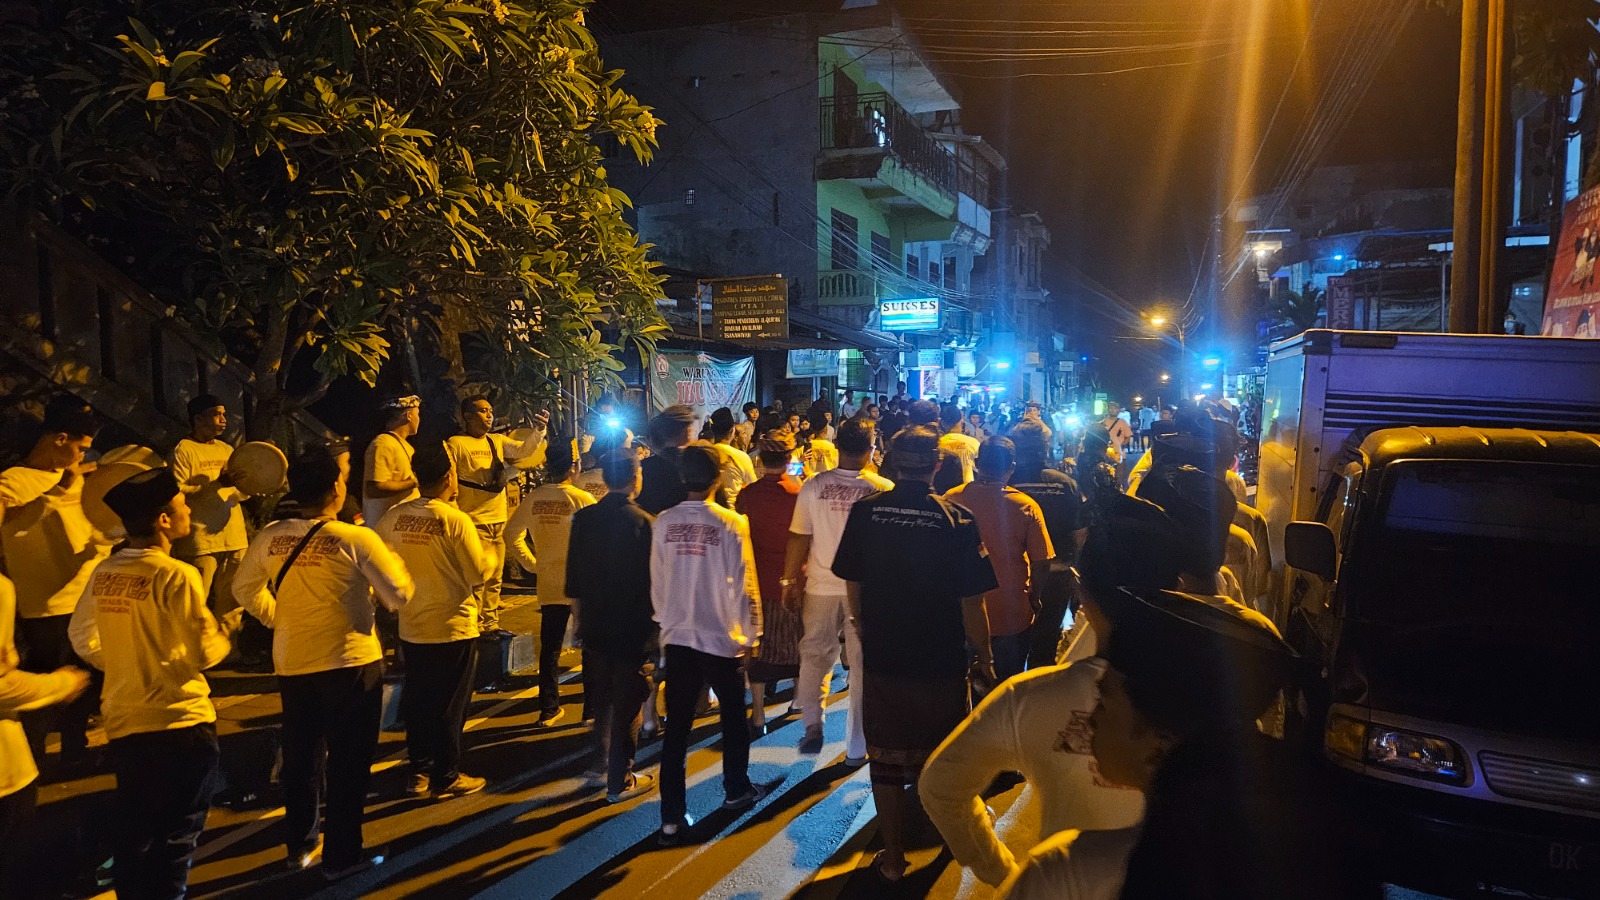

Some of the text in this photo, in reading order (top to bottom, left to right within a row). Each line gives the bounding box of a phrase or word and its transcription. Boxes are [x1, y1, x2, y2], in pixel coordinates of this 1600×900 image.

[883, 301, 936, 312] SUKSES
[676, 380, 705, 405] IBU
[1550, 842, 1581, 870] DK
